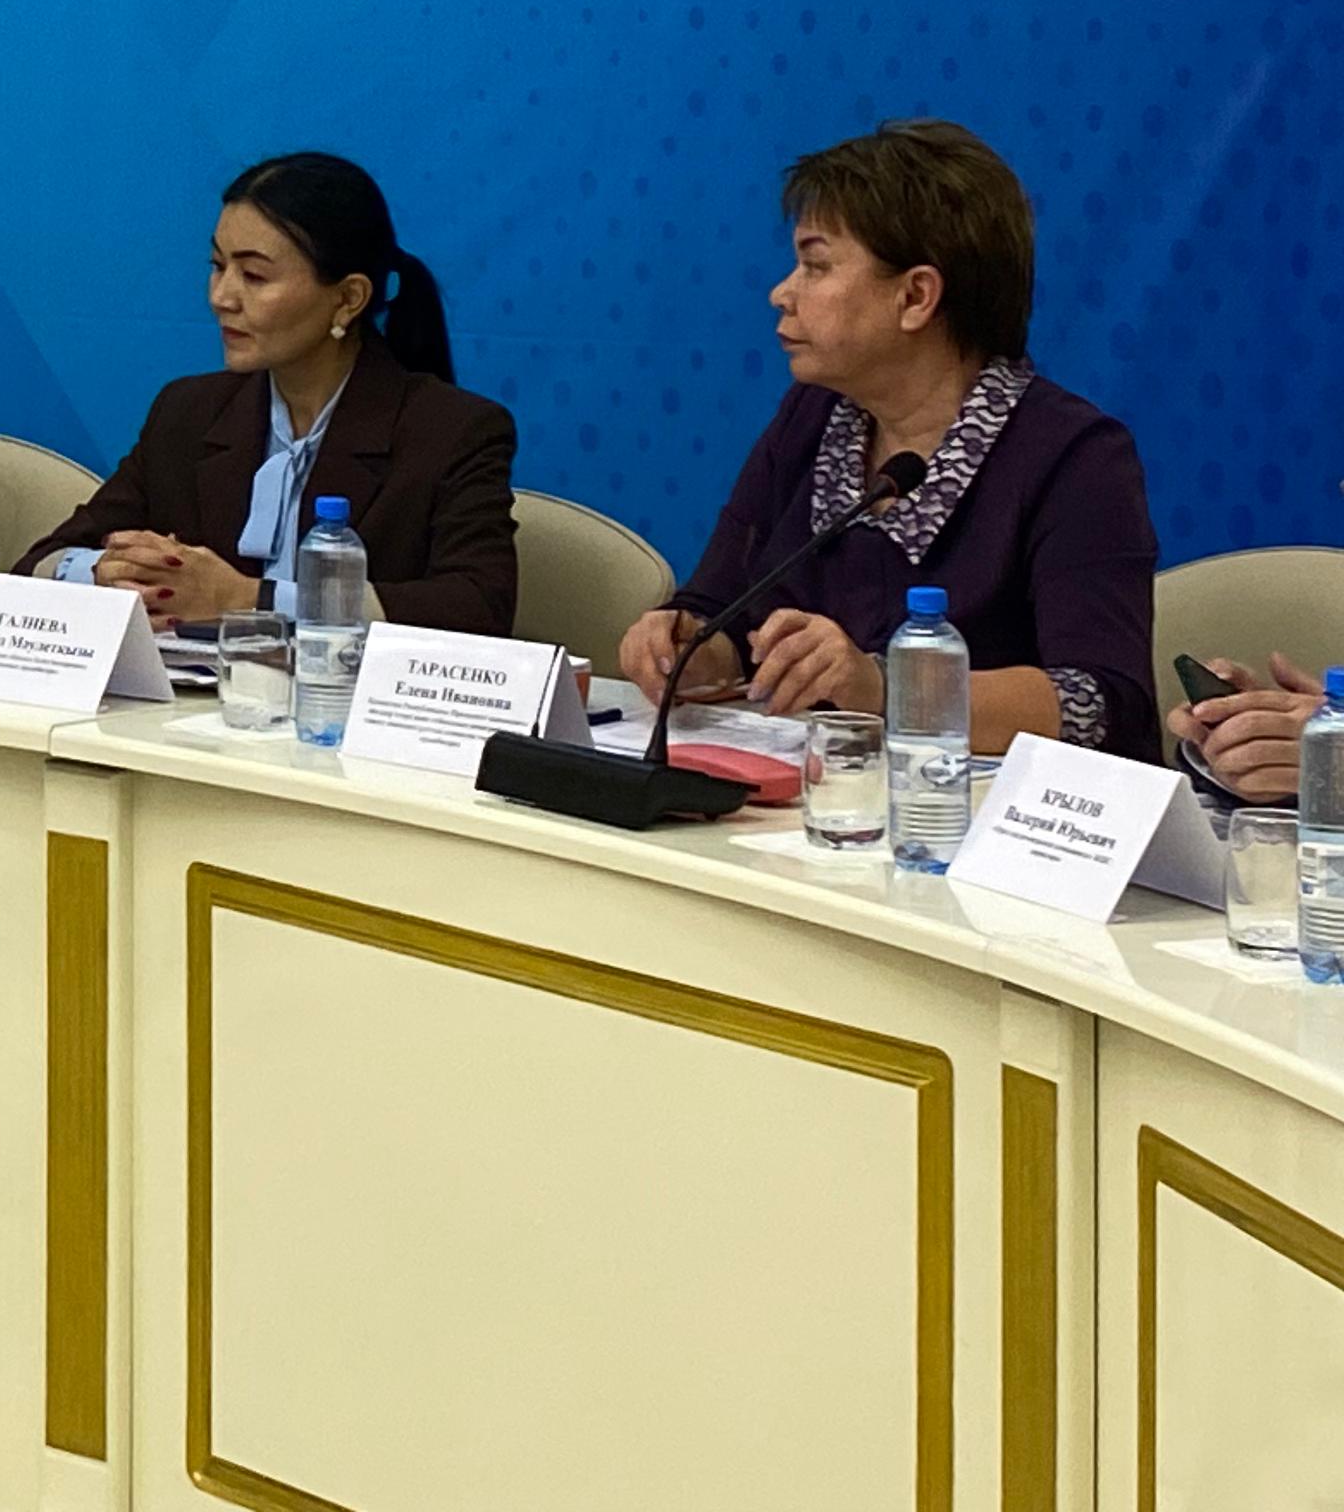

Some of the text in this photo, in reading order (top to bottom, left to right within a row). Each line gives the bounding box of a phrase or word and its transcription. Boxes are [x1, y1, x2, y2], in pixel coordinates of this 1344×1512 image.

[407, 658, 508, 687] ТАРАСЕНКО
[394, 680, 512, 711] Елена Ивановна
[1040, 788, 1105, 818] КРЫЛОВ
[1003, 805, 1117, 849] Валерий Юрьевич
